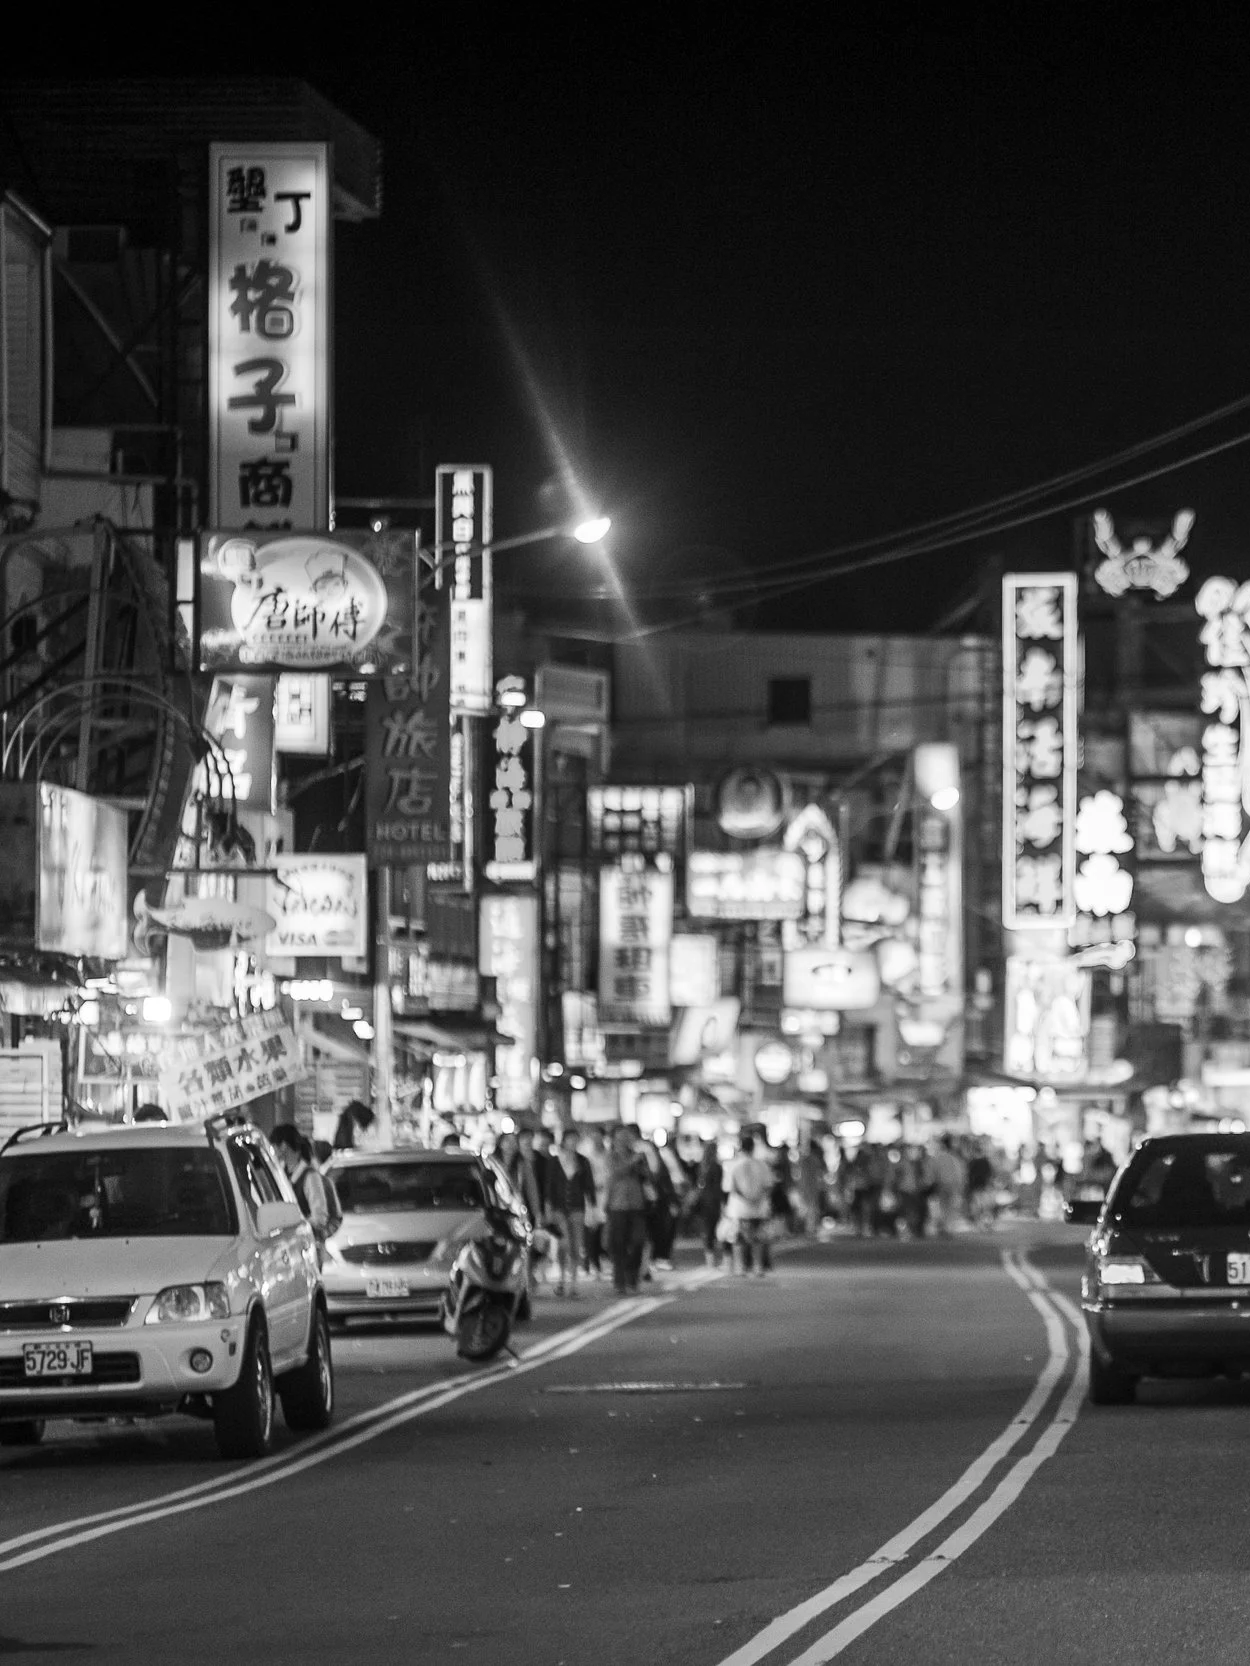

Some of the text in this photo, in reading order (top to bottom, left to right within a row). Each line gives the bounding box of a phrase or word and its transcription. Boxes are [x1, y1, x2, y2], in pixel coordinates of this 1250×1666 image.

[244, 585, 366, 642] 唐師傅
[375, 820, 446, 842] HOTEL
[278, 932, 318, 947] VISA
